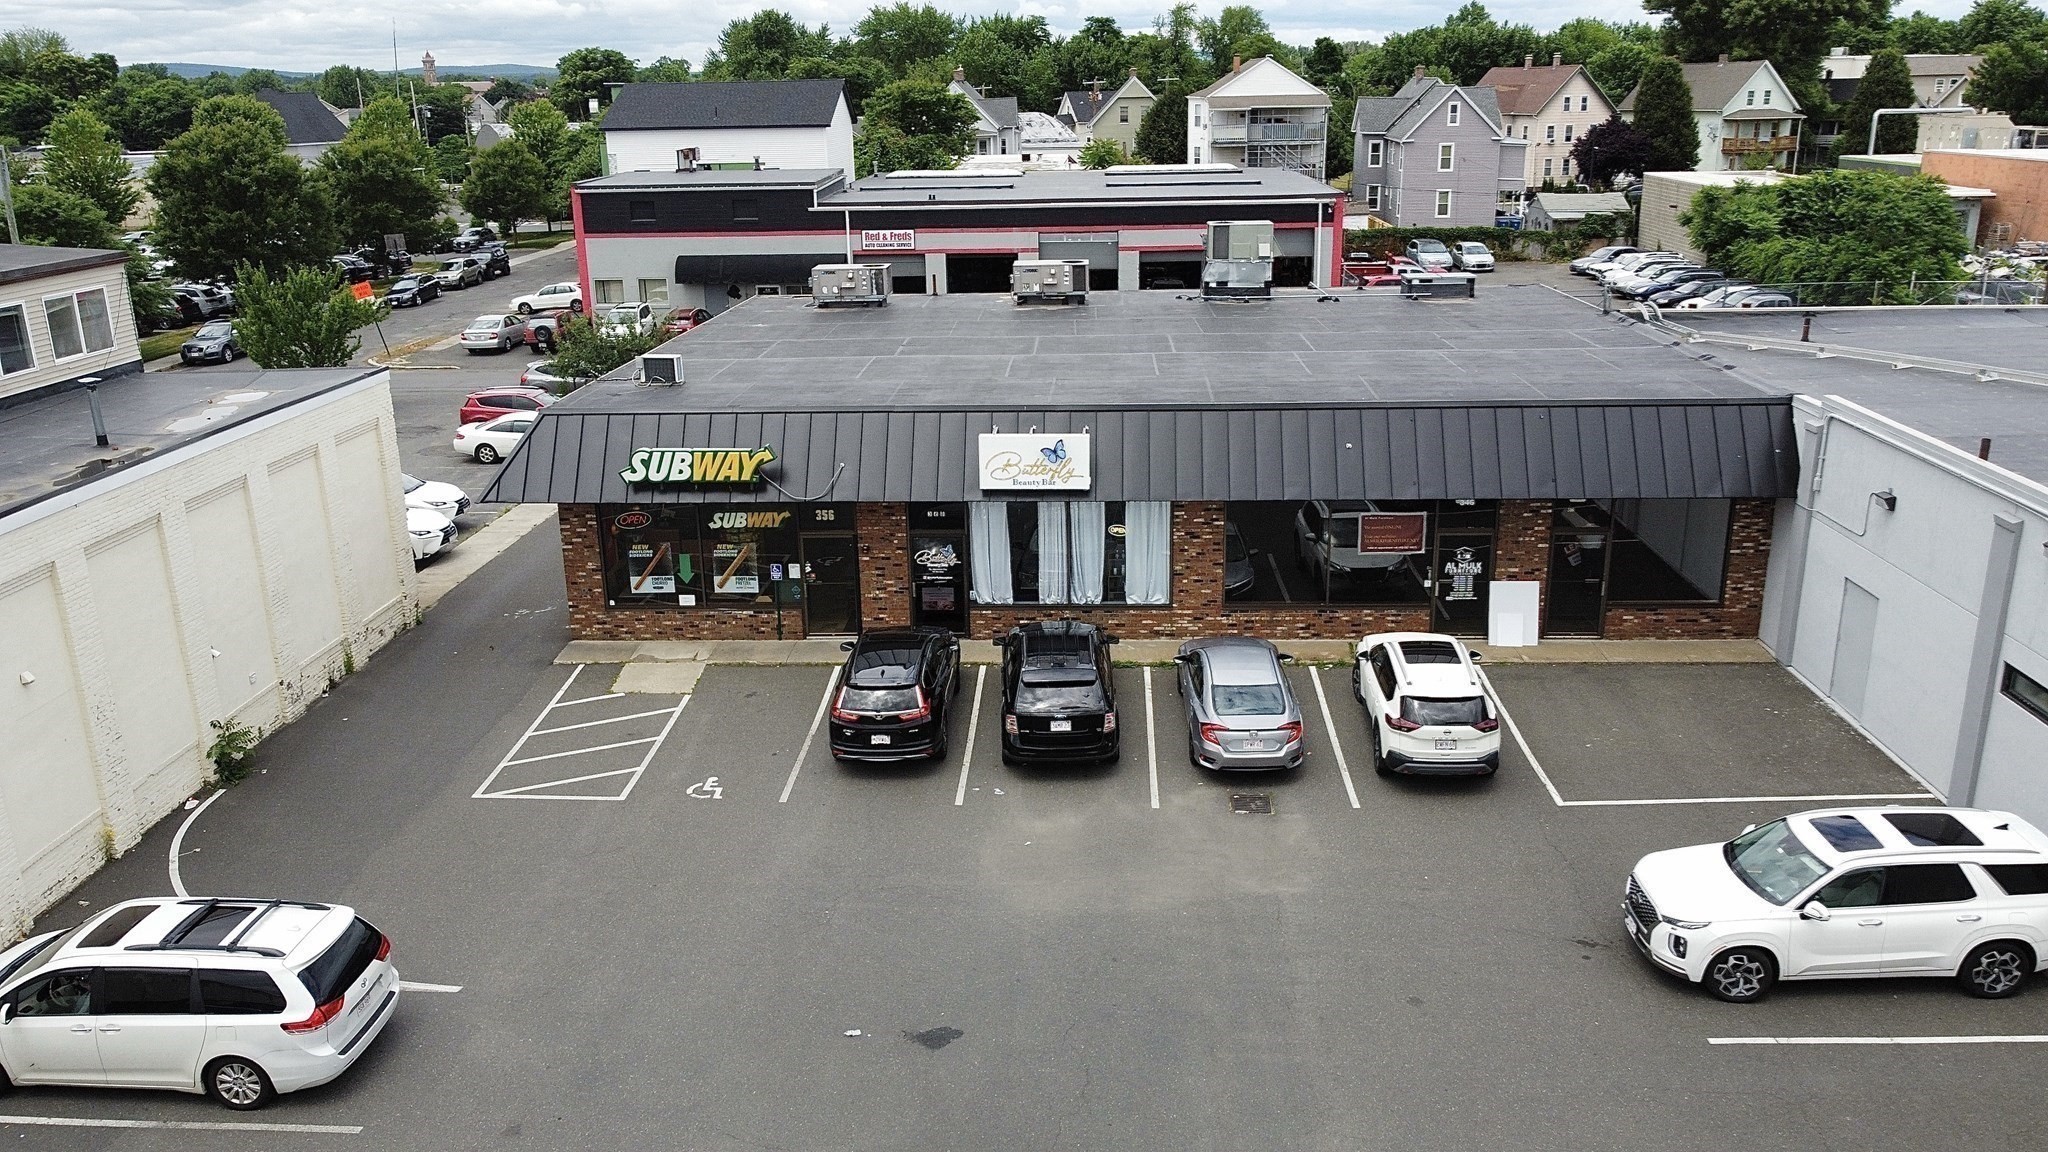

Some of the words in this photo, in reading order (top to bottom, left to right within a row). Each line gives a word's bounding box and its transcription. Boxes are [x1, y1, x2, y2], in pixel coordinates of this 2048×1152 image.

[864, 231, 880, 241] Red
[882, 233, 888, 241] &
[620, 449, 774, 483] SUBWAY
[985, 451, 1084, 484] Butterfly
[1012, 478, 1041, 487] Beauty
[1041, 478, 1056, 486] Bar
[619, 515, 647, 524] OPEN
[708, 510, 791, 530] SUBWAY
[815, 509, 835, 521] 356
[1445, 562, 1457, 570] AL
[1458, 562, 1482, 570] MULK
